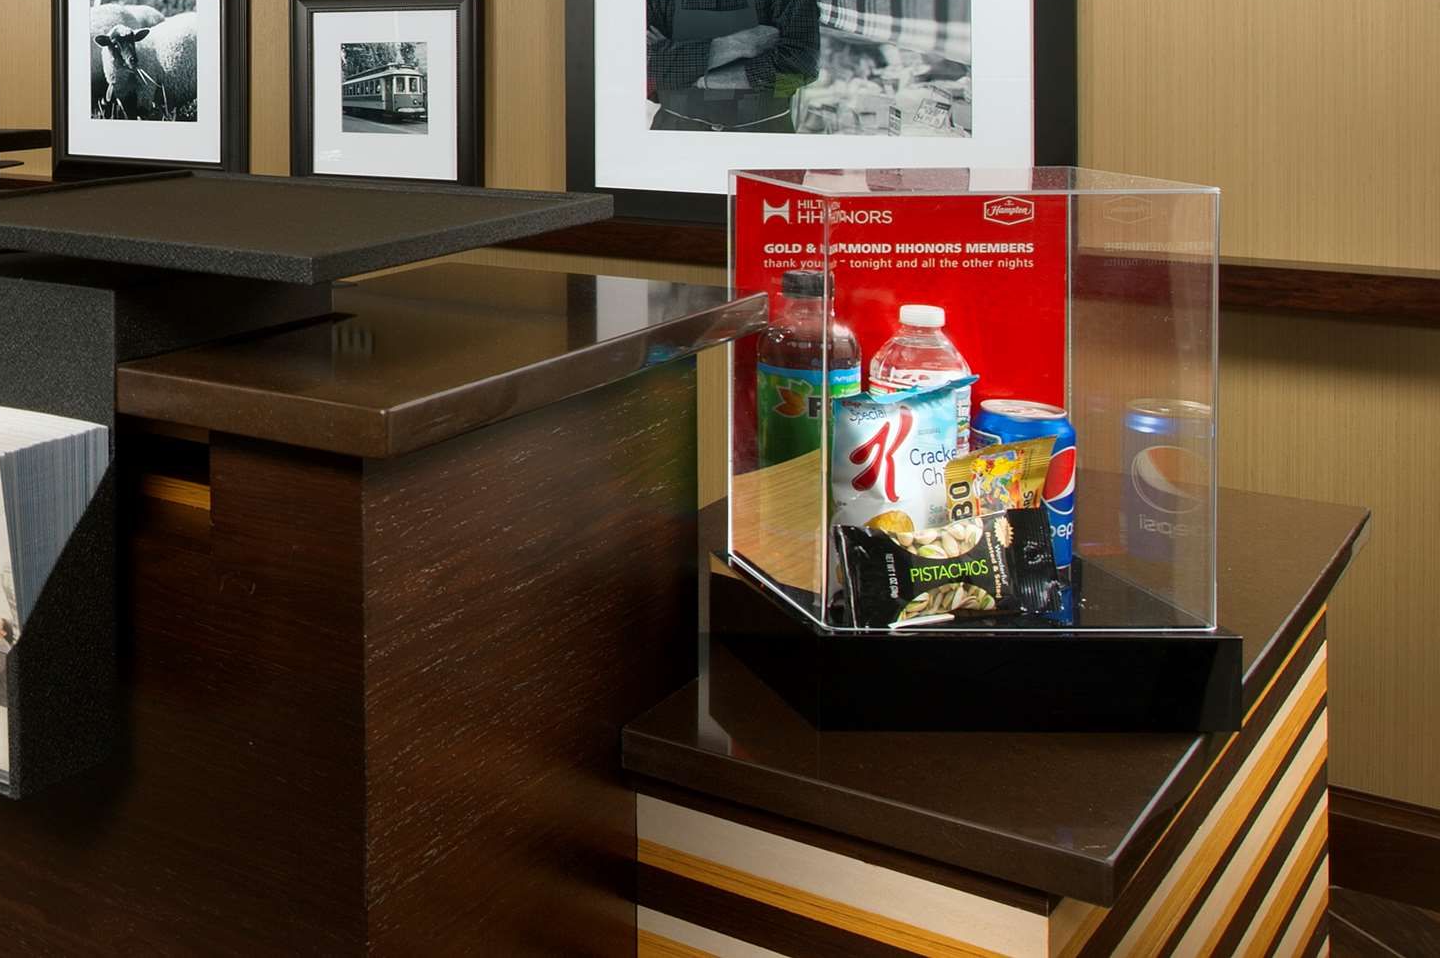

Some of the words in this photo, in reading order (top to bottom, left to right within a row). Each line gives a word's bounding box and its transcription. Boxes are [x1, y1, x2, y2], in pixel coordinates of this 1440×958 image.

[797, 199, 840, 210] HILT
[986, 204, 1032, 217] Hampton
[797, 210, 893, 224] HHNORS
[764, 243, 802, 254] GOLD
[806, 243, 816, 254] &
[895, 243, 962, 254] HHONORS
[965, 243, 1035, 254] MEMBERS
[764, 257, 797, 268] thank
[850, 258, 893, 270] tonight
[896, 258, 918, 268] and
[921, 258, 936, 268] all
[940, 258, 959, 268] the
[962, 258, 994, 268] other
[998, 258, 1034, 270] nights
[849, 407, 888, 425] Special
[910, 444, 958, 466] Cracke
[910, 559, 989, 583] PISTACHIOS
